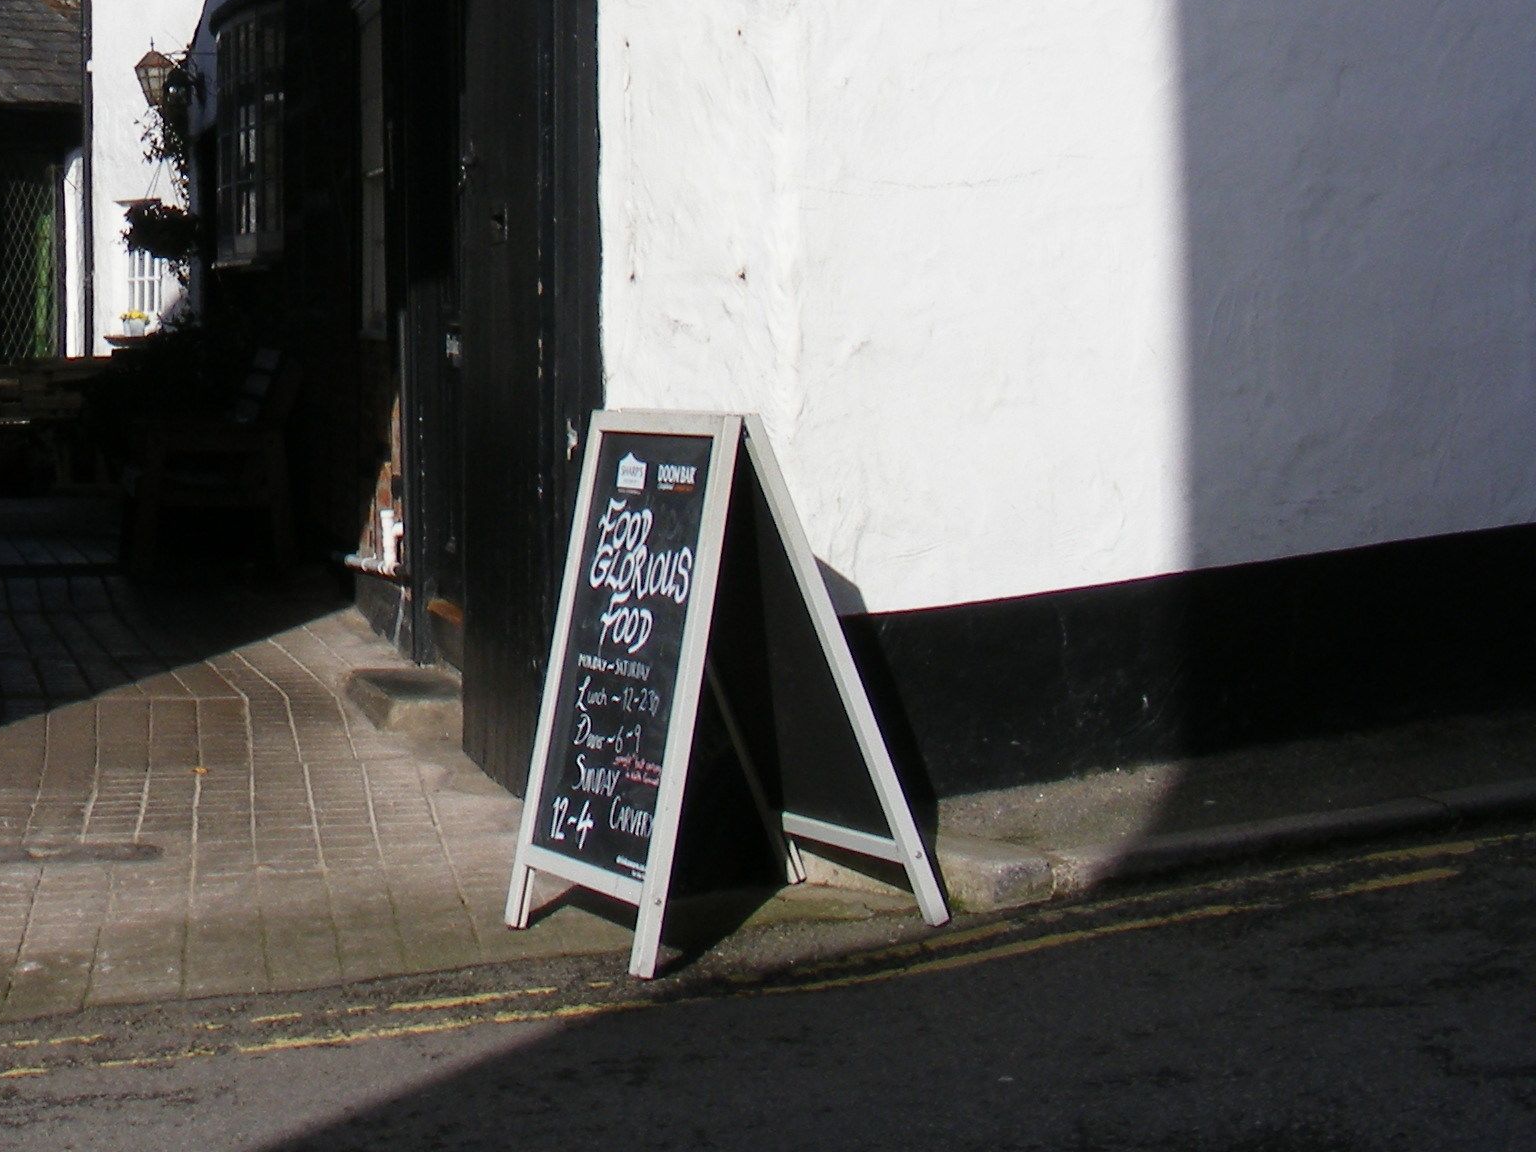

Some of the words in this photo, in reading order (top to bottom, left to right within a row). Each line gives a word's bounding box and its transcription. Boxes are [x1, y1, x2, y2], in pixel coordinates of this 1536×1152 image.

[598, 497, 653, 554] FOOD
[590, 543, 692, 604] GLORIOUS
[600, 589, 653, 654] FOOD
[572, 754, 621, 796] SUNDAY
[551, 796, 594, 849] 12-4
